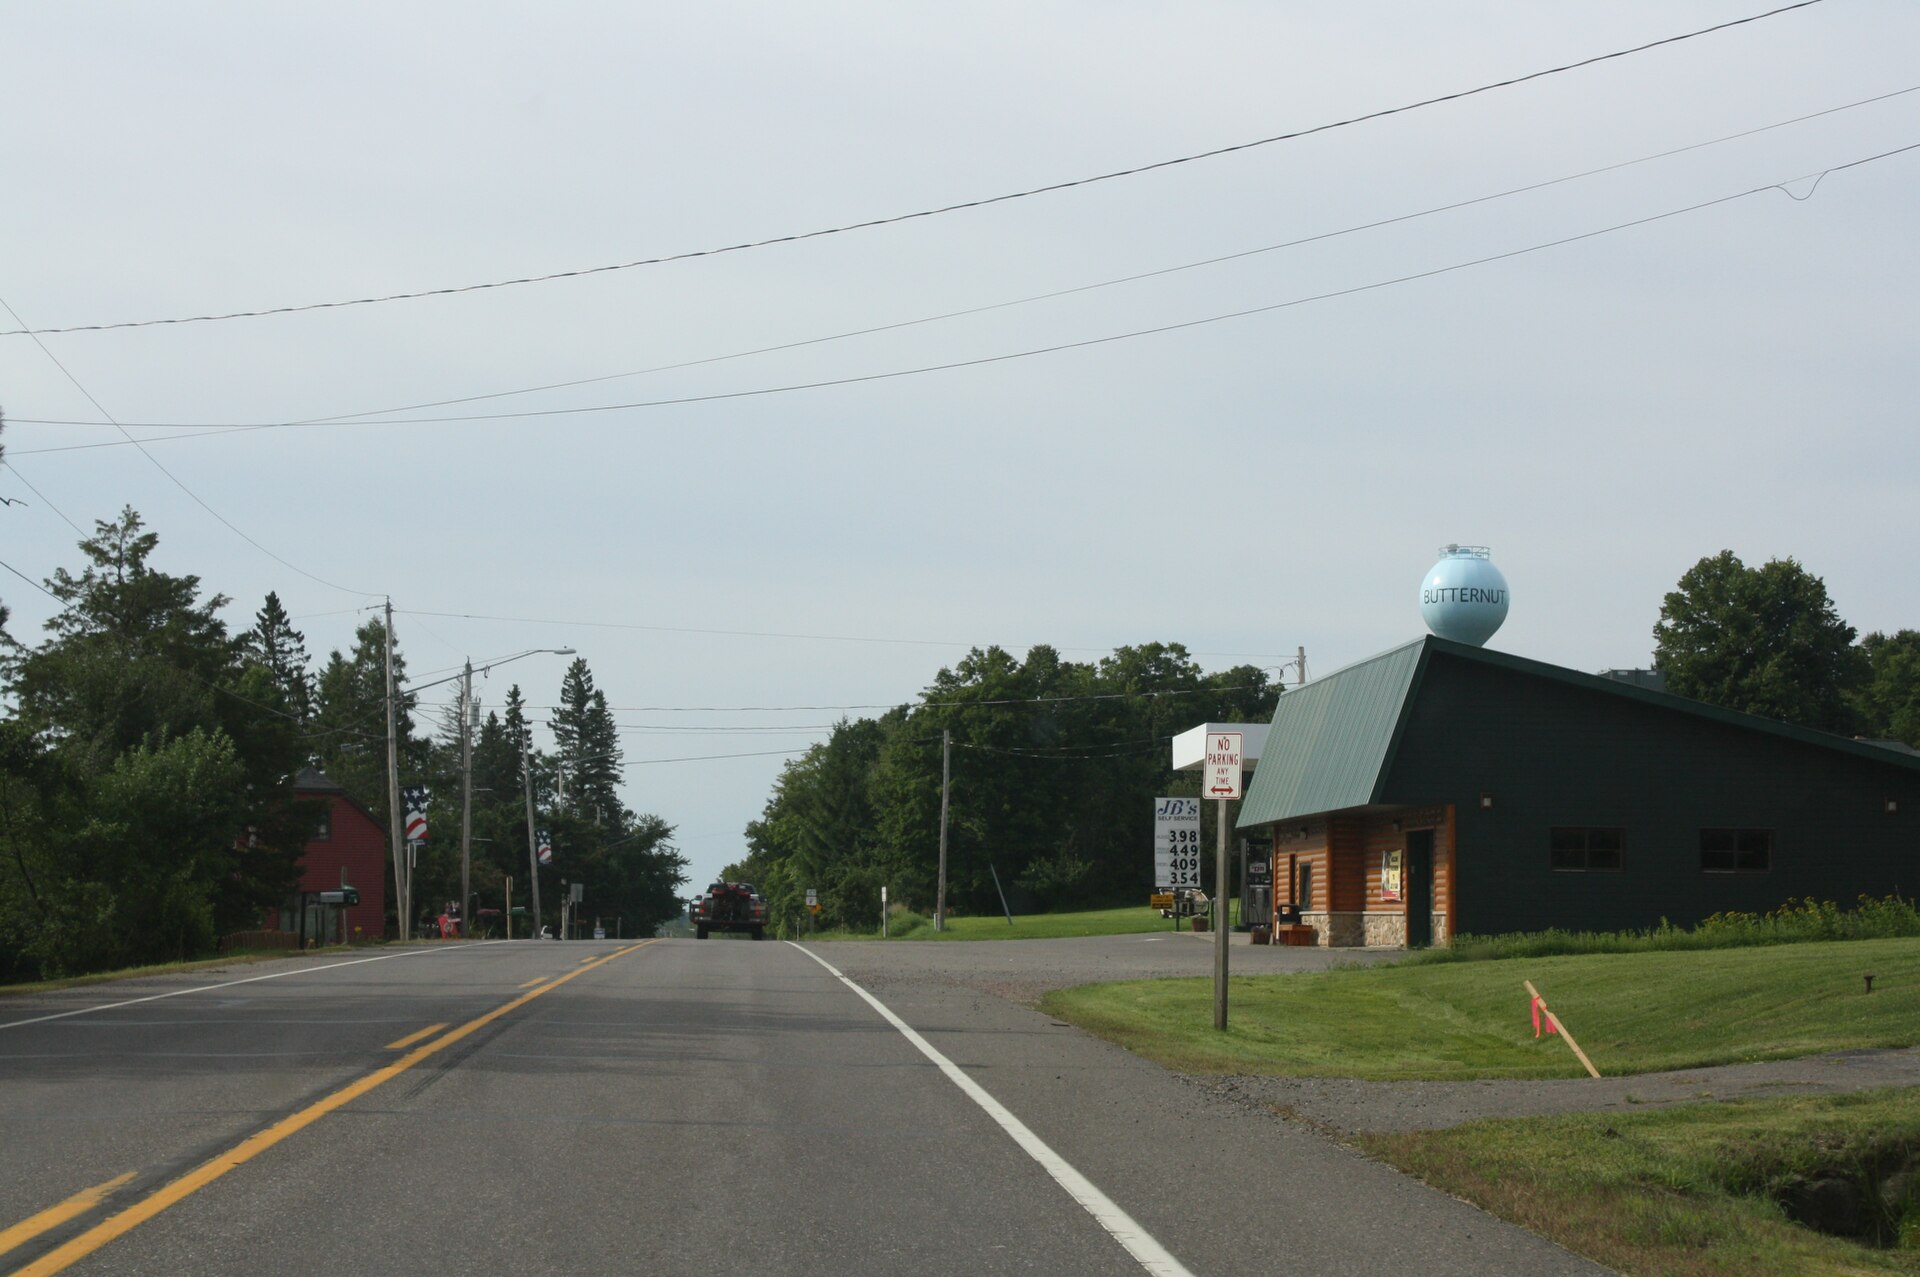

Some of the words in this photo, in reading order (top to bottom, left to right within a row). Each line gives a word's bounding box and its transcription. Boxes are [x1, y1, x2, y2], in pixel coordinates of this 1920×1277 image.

[1424, 587, 1506, 605] BUTTERNUT
[1217, 738, 1230, 751] NO
[1208, 753, 1239, 766] PARKING
[1216, 767, 1229, 776] ANY
[1215, 776, 1229, 785] TIME
[1157, 799, 1198, 816] JB's
